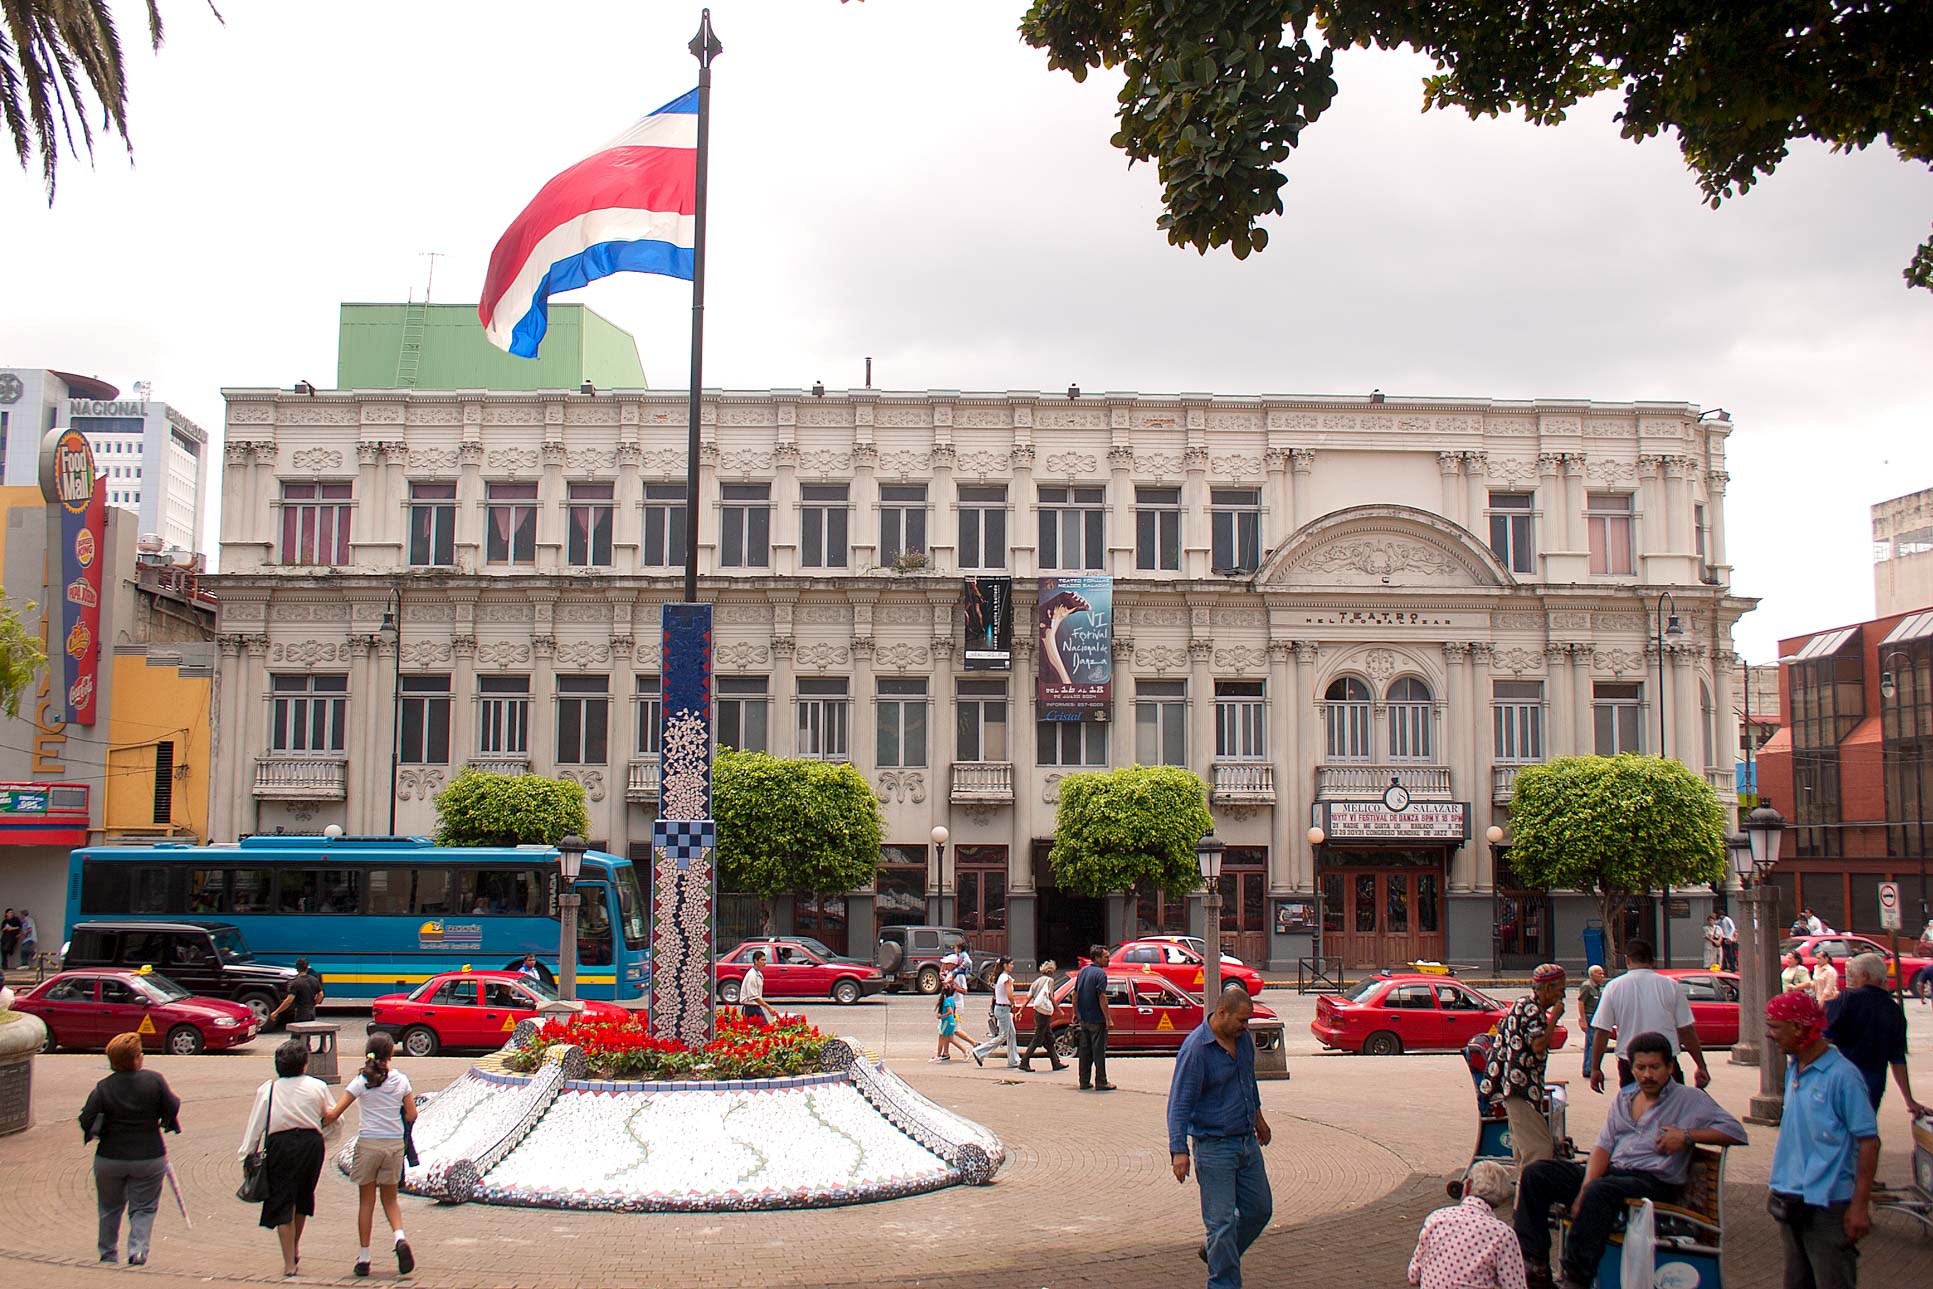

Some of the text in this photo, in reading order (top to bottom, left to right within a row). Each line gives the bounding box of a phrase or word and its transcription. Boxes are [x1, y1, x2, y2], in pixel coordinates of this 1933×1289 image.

[70, 401, 149, 416] NACIONAL
[61, 444, 87, 472] Food
[63, 472, 89, 501] Mall
[78, 545, 93, 557] KING
[1086, 611, 1108, 628] VI
[1339, 612, 1418, 620] TEATRO
[1072, 627, 1108, 642] Festival
[1062, 637, 1099, 656] Nacional
[1072, 653, 1108, 675] Danza
[1061, 685, 1076, 694] 16
[1089, 685, 1104, 694] 18
[1046, 709, 1082, 721] Cristal
[1343, 804, 1458, 813] MELICO SALAZAR
